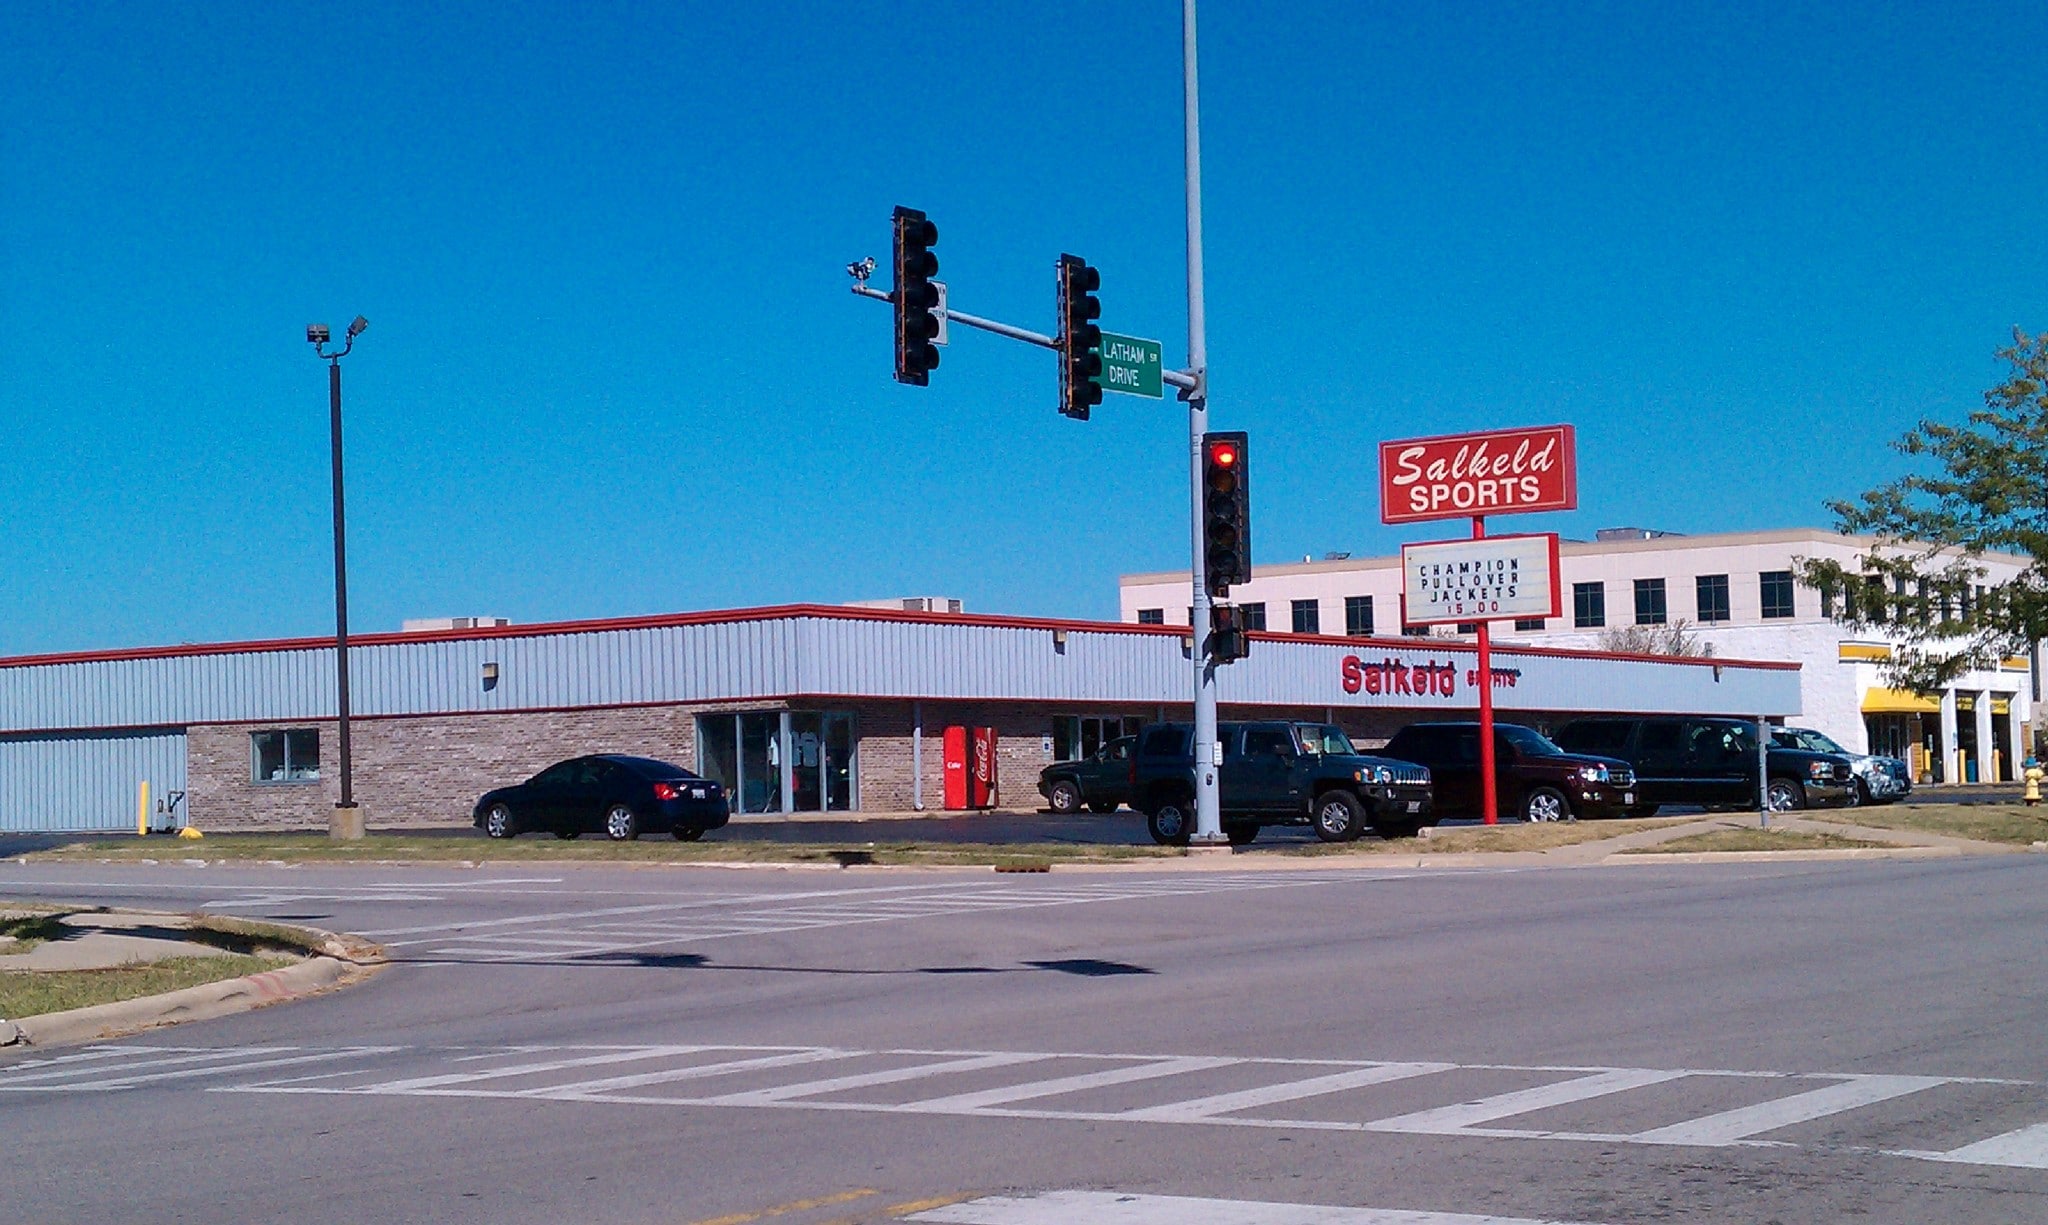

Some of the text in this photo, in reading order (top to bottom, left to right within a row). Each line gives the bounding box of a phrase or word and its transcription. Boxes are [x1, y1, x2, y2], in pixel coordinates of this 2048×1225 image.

[1103, 340, 1145, 364] LATHAM
[1109, 365, 1139, 387] DRIVE
[1392, 437, 1556, 486] Salkeld
[1409, 475, 1541, 513] SPORTS
[1420, 558, 1518, 577] CHAMPION
[1421, 572, 1518, 590] PULLOVER
[1431, 586, 1516, 603] JACKETS
[1342, 655, 1517, 697] Salkeld SPRTS
